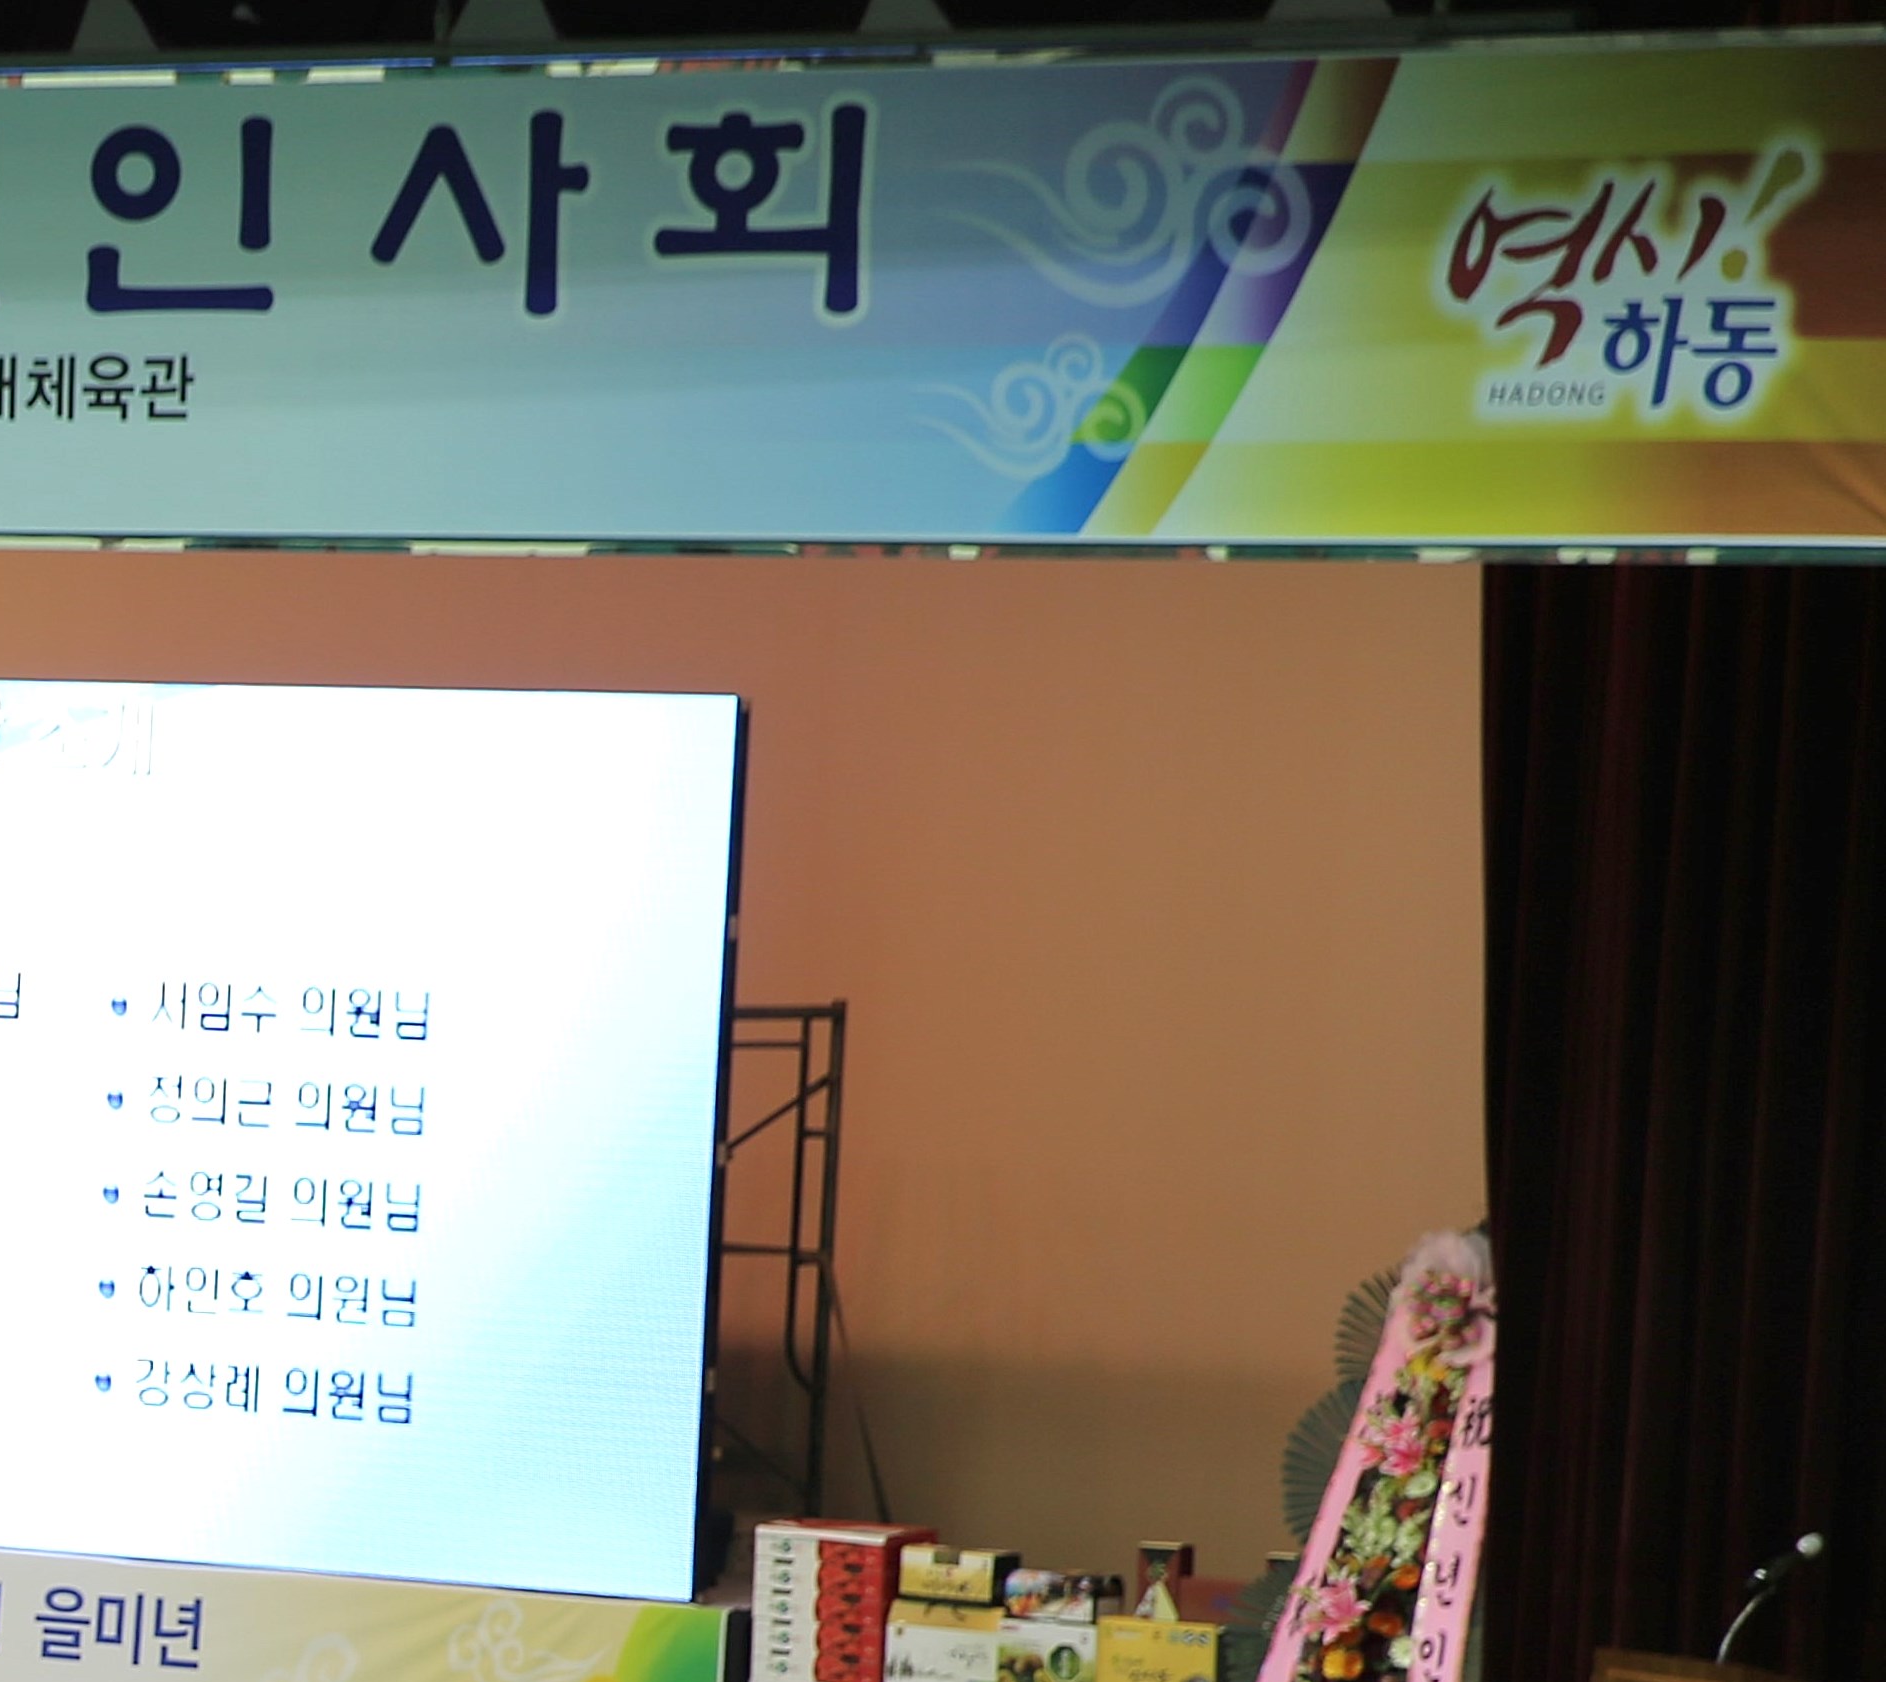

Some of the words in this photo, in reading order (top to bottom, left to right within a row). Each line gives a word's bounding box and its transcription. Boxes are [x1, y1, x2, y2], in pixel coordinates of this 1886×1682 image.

[1448, 150, 1806, 368] 역시!
[1604, 297, 1779, 410] 하동
[1488, 381, 1606, 404] HADONG
[300, 986, 430, 1041] 의원님
[149, 1075, 272, 1128] 정의근
[295, 1081, 425, 1136] 의원님
[144, 1170, 268, 1225] 손영길
[291, 1176, 420, 1233] 의원님
[139, 1265, 264, 1315] 하인호
[287, 1272, 417, 1327] 의원님
[282, 1367, 414, 1424] 의원님
[34, 1584, 206, 1671] 을미년
